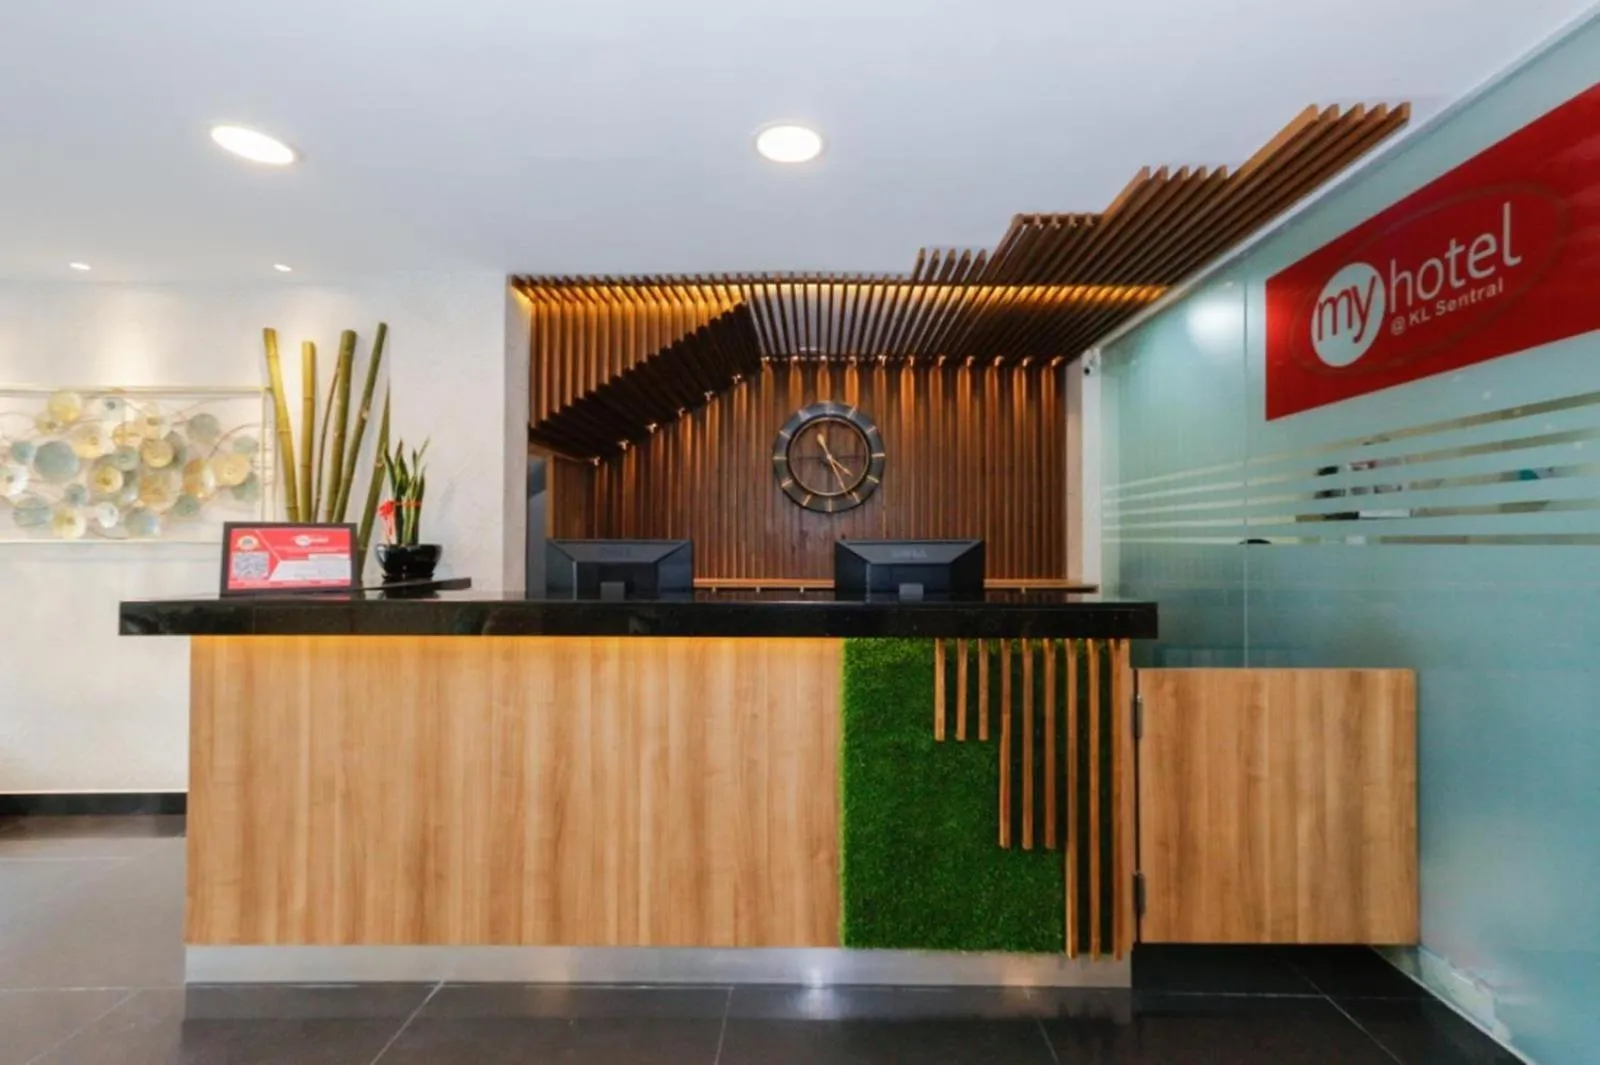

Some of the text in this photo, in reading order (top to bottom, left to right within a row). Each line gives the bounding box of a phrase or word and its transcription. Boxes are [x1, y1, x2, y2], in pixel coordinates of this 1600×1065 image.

[1391, 276, 1504, 336] @ KL Sentral
